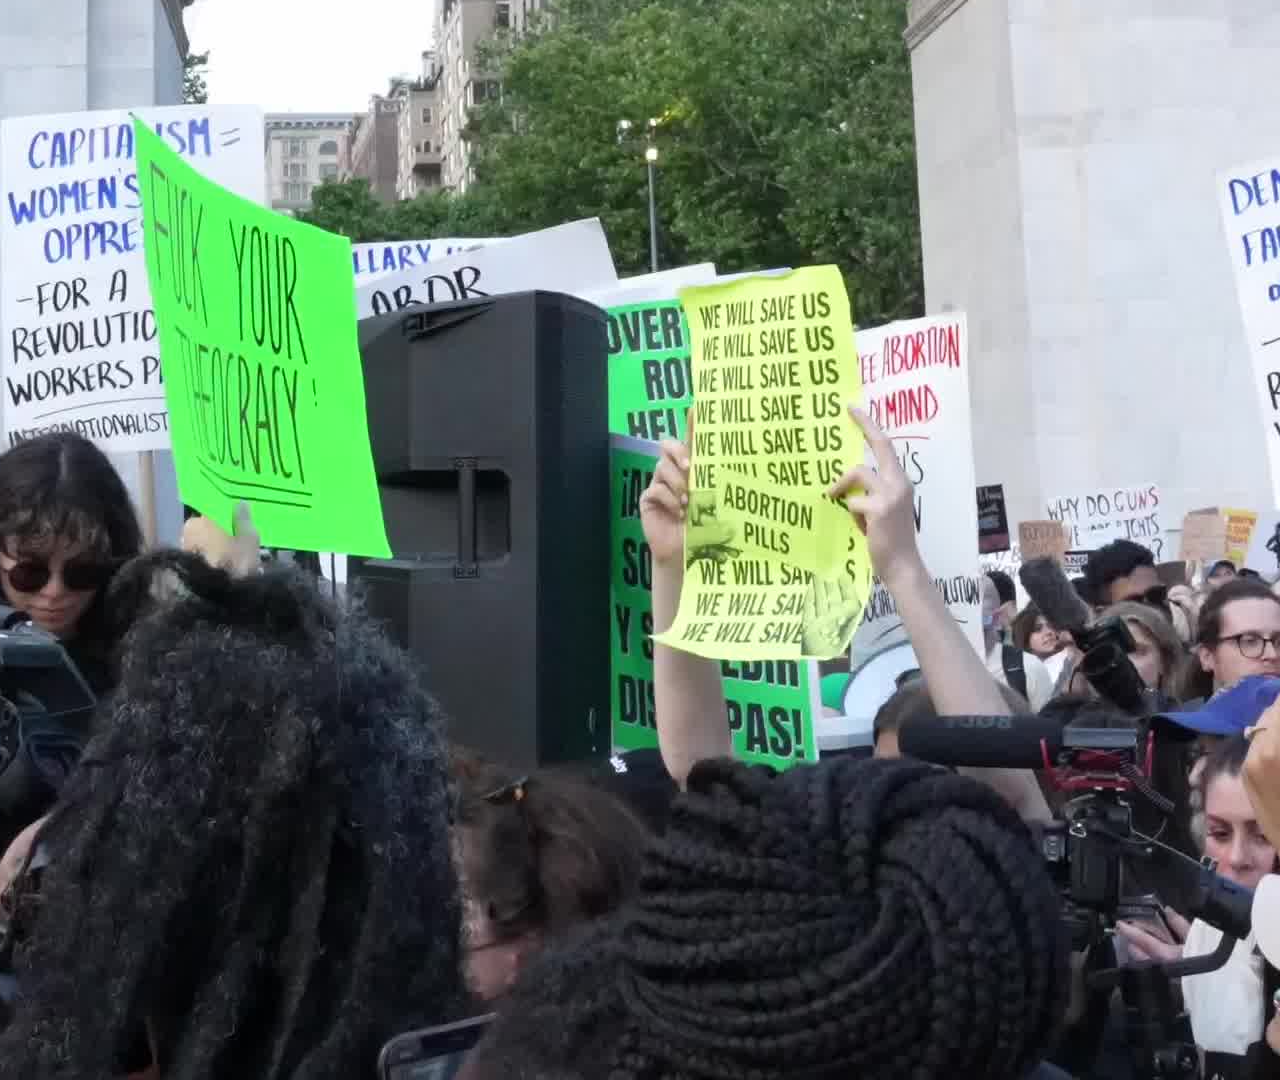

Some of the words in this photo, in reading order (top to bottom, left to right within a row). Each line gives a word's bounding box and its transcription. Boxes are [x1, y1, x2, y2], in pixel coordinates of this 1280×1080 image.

[28, 119, 211, 169] CAPITAISM
[44, 219, 145, 264] OPPRE
[151, 160, 209, 328] FUCK
[229, 217, 309, 364] YOUR
[109, 269, 128, 302] A
[699, 304, 722, 330] WE
[725, 300, 756, 325] WILL
[760, 295, 796, 321] SAVE
[802, 291, 831, 318] US
[608, 306, 691, 355] OVER
[701, 336, 722, 361] WE
[723, 333, 756, 359] WILL
[759, 330, 798, 355] SAVE
[804, 325, 835, 352] US
[882, 323, 961, 379] ABORTION
[7, 362, 134, 408] WORKERS
[698, 368, 717, 392] WE
[721, 367, 754, 390] WILL
[759, 361, 801, 388] SAVE
[809, 358, 840, 385] US
[696, 400, 717, 424] WE
[720, 398, 756, 423] WILL
[760, 394, 802, 422] SAVE
[812, 391, 841, 419] US
[694, 432, 716, 457] WE
[720, 431, 758, 456] WILL
[763, 426, 807, 453] SAVE
[814, 425, 843, 451] US
[694, 463, 717, 489] WE
[724, 483, 813, 531] ABORTION
[1086, 494, 1110, 517] DO
[743, 522, 791, 555] PILLS
[699, 559, 726, 586] WE
[732, 560, 774, 586] WILL
[695, 592, 723, 616] WE
[727, 592, 768, 616] WILL
[681, 622, 714, 643] WE
[714, 622, 758, 643] WILL
